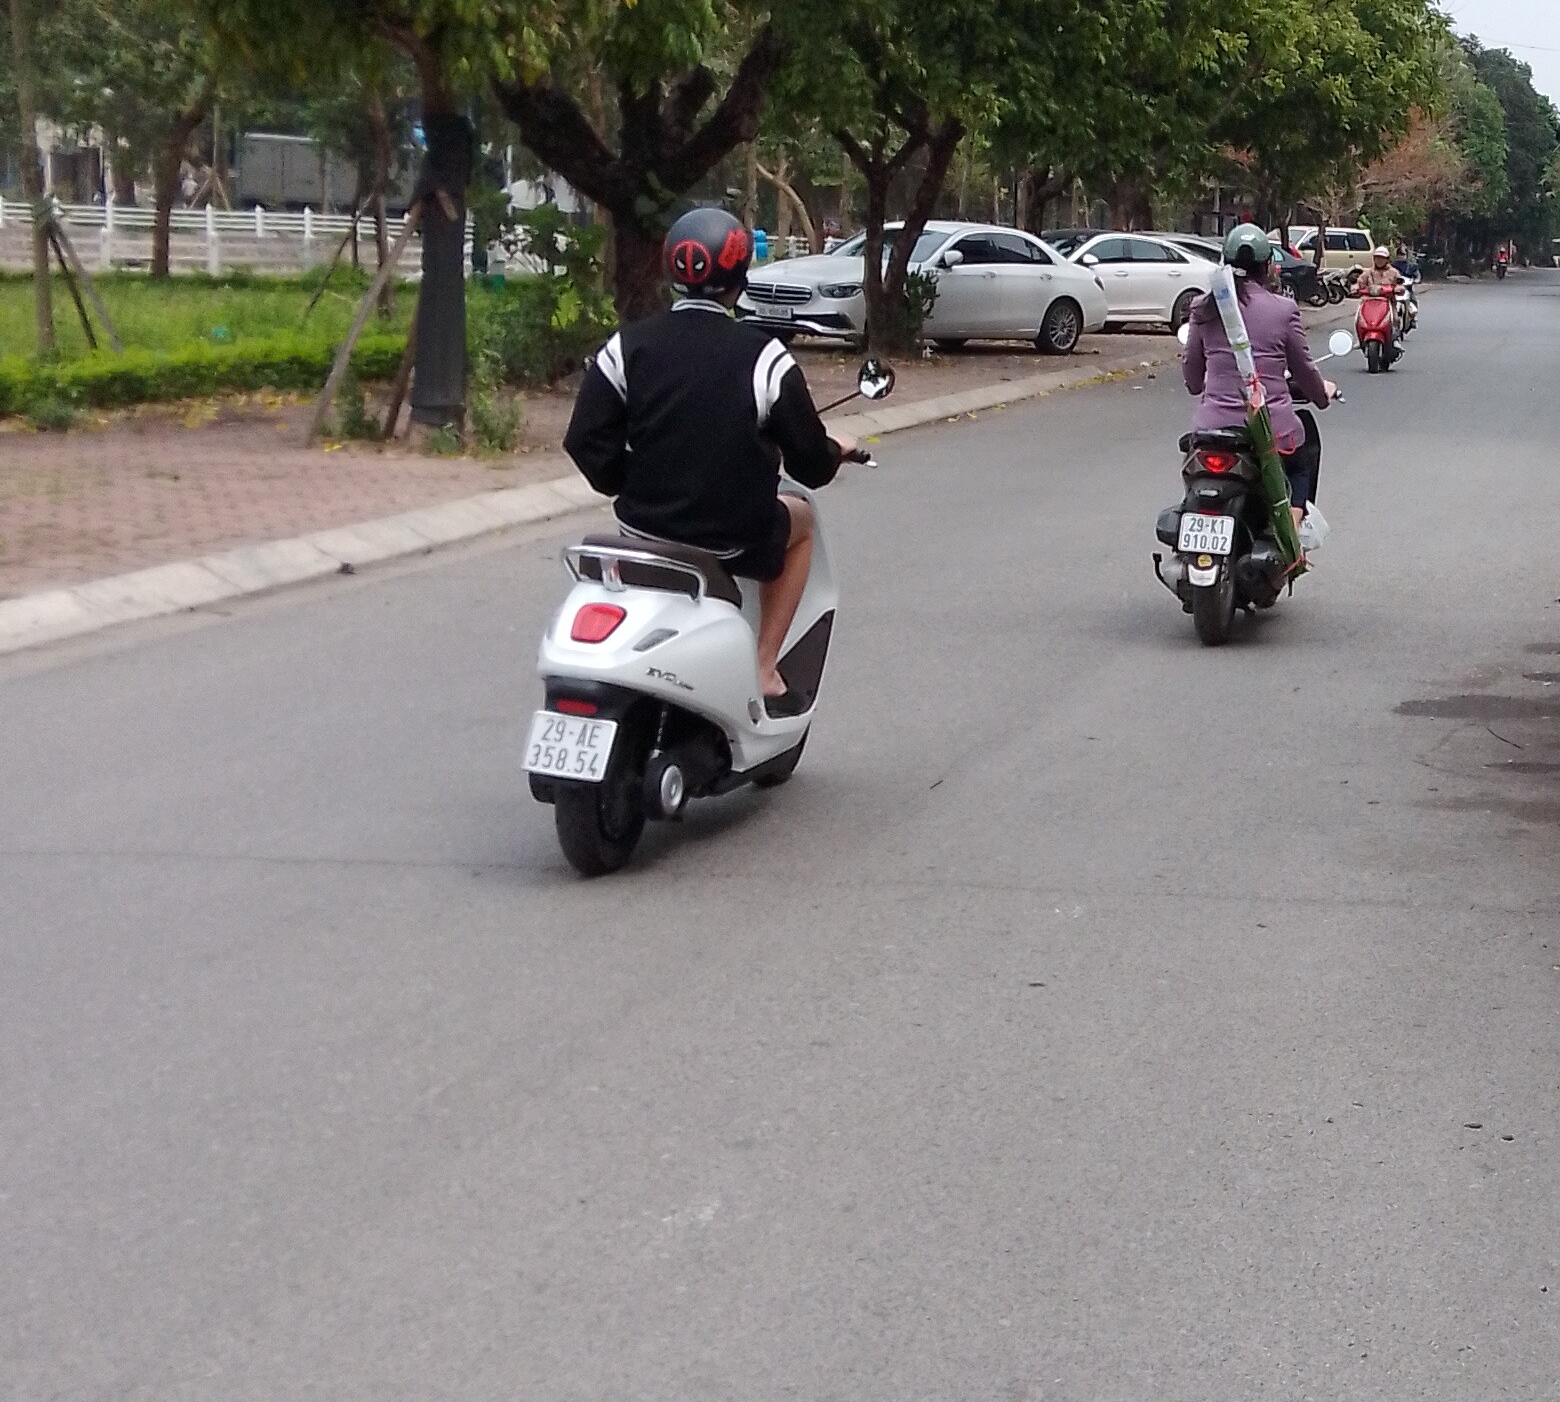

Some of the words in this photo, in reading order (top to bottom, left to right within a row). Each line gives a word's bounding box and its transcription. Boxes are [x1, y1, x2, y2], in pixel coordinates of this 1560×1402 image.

[1188, 517, 1226, 535] 29-K1
[1183, 533, 1228, 552] 910.02
[541, 718, 602, 749] 29-AE
[528, 744, 600, 777] 358.54
